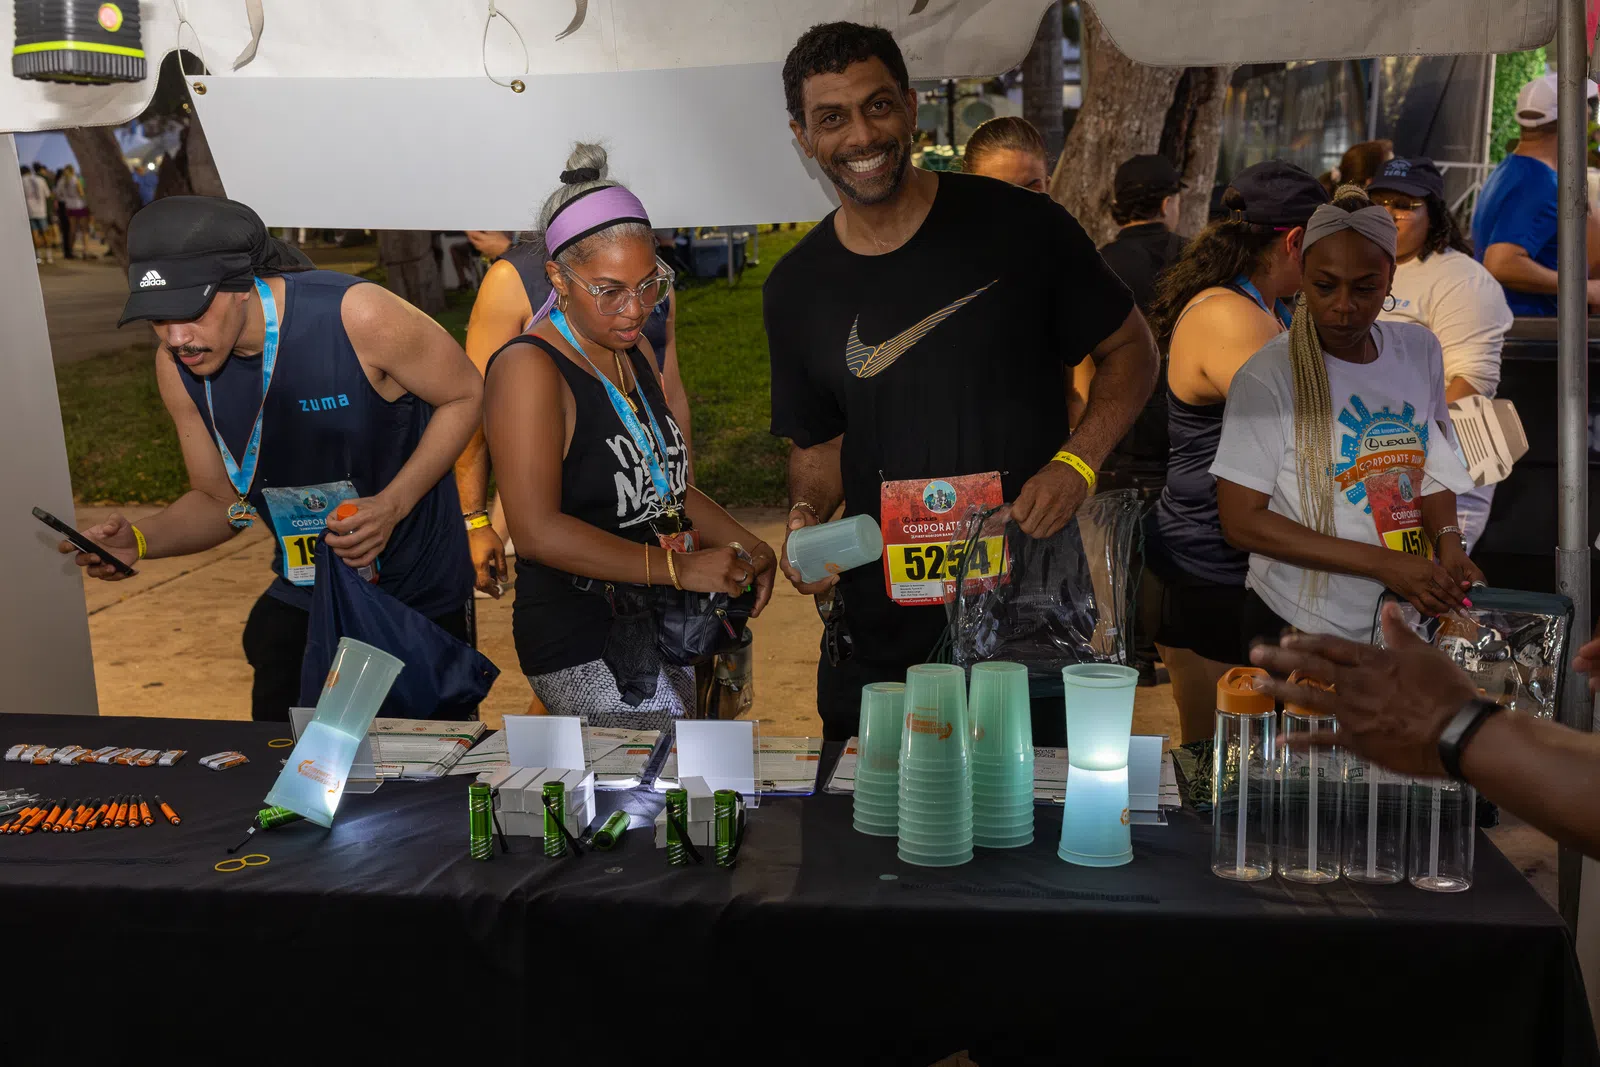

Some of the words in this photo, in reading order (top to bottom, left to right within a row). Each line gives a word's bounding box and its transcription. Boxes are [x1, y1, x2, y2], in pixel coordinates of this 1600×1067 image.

[140, 279, 166, 288] adidas
[298, 393, 350, 412] zuma
[1380, 436, 1417, 447] LEXUS
[1359, 453, 1409, 471] CORPORATE
[902, 521, 961, 534] CORPORATE
[903, 540, 991, 581] 5254
